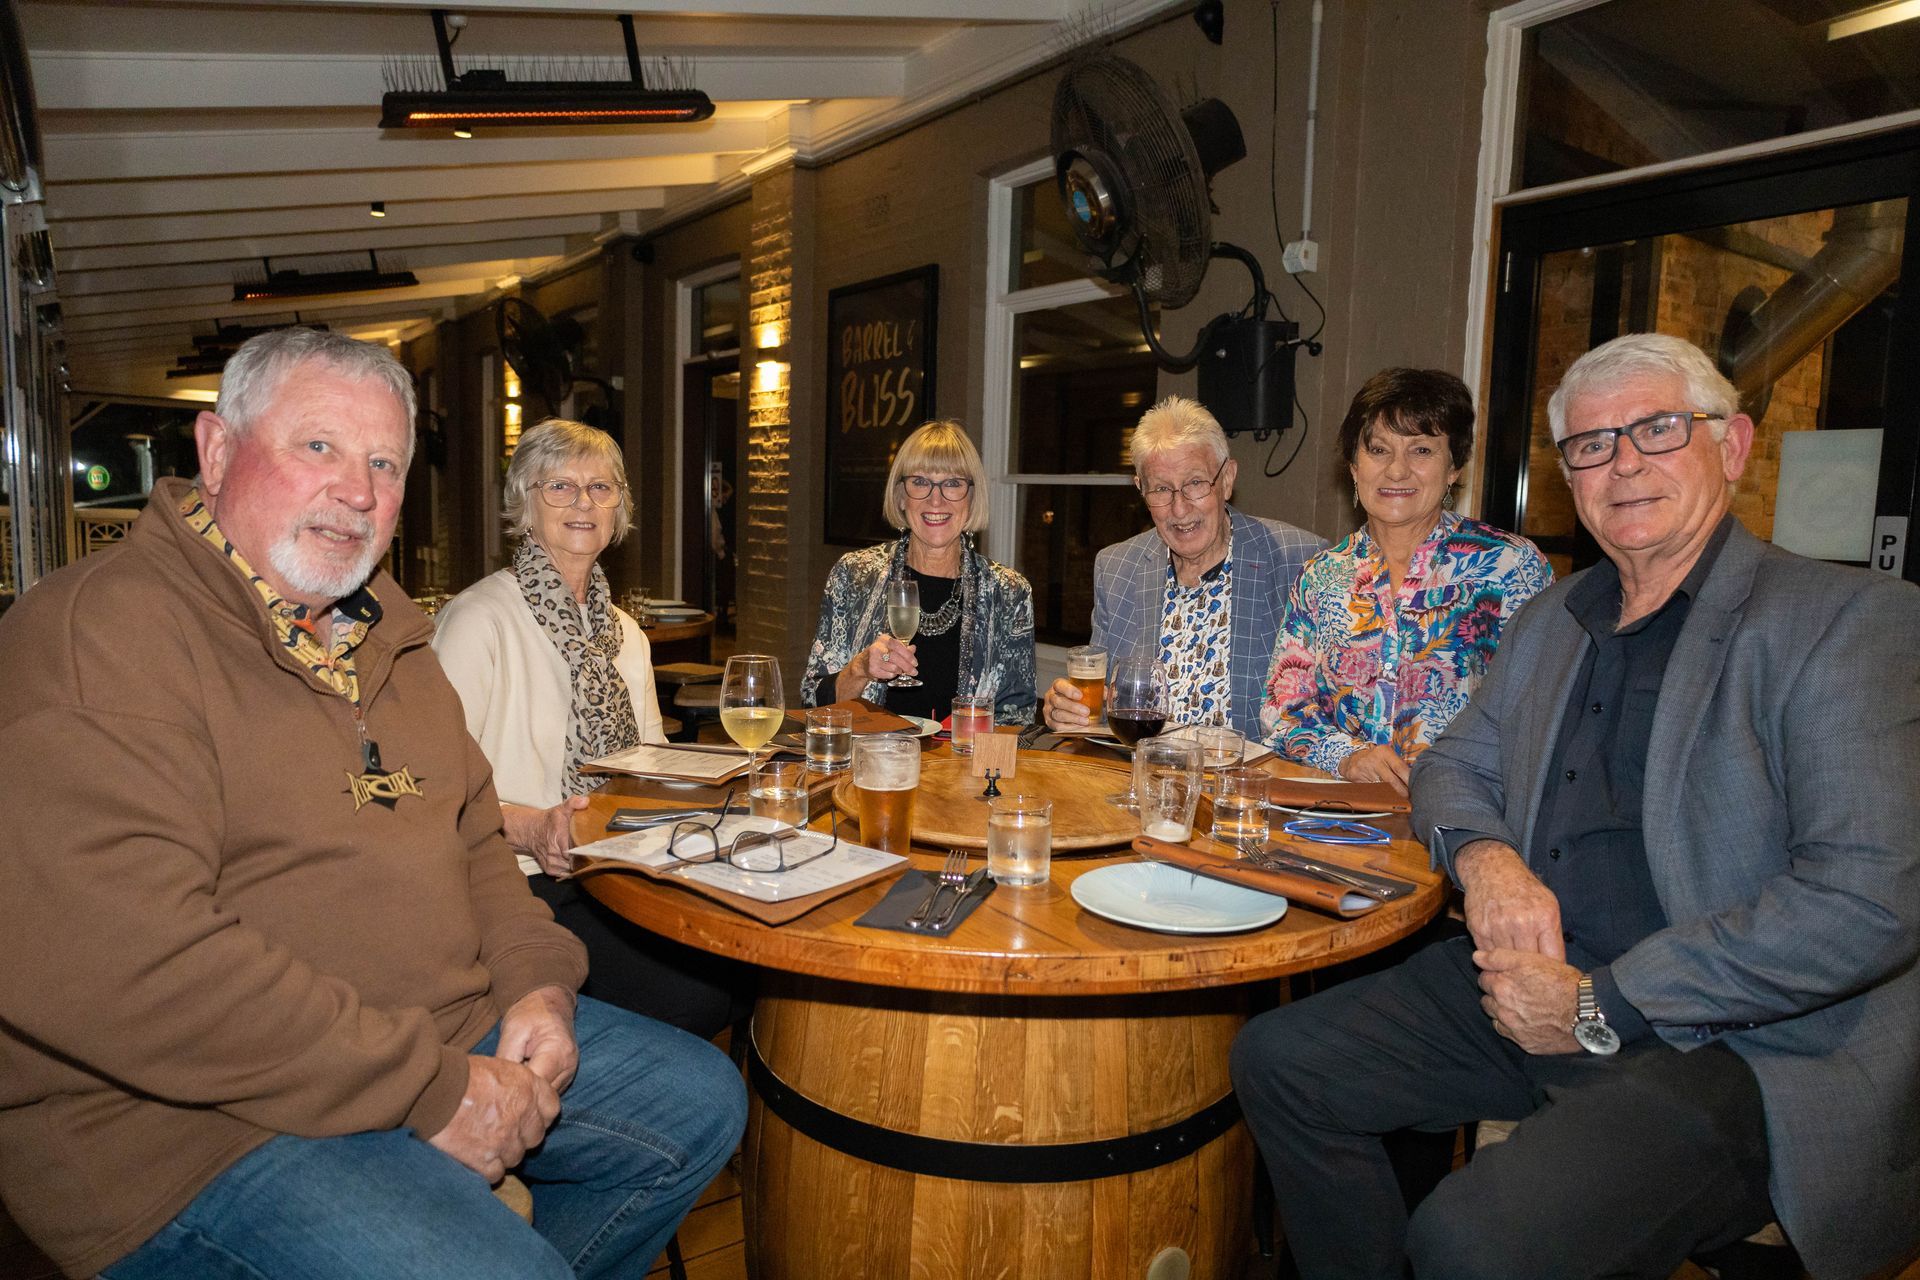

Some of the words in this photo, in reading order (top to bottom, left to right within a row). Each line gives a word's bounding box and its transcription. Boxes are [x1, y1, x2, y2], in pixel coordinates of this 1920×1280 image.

[842, 321, 902, 367] BARREL
[841, 367, 915, 434] BLISS
[1878, 534, 1898, 571] PU
